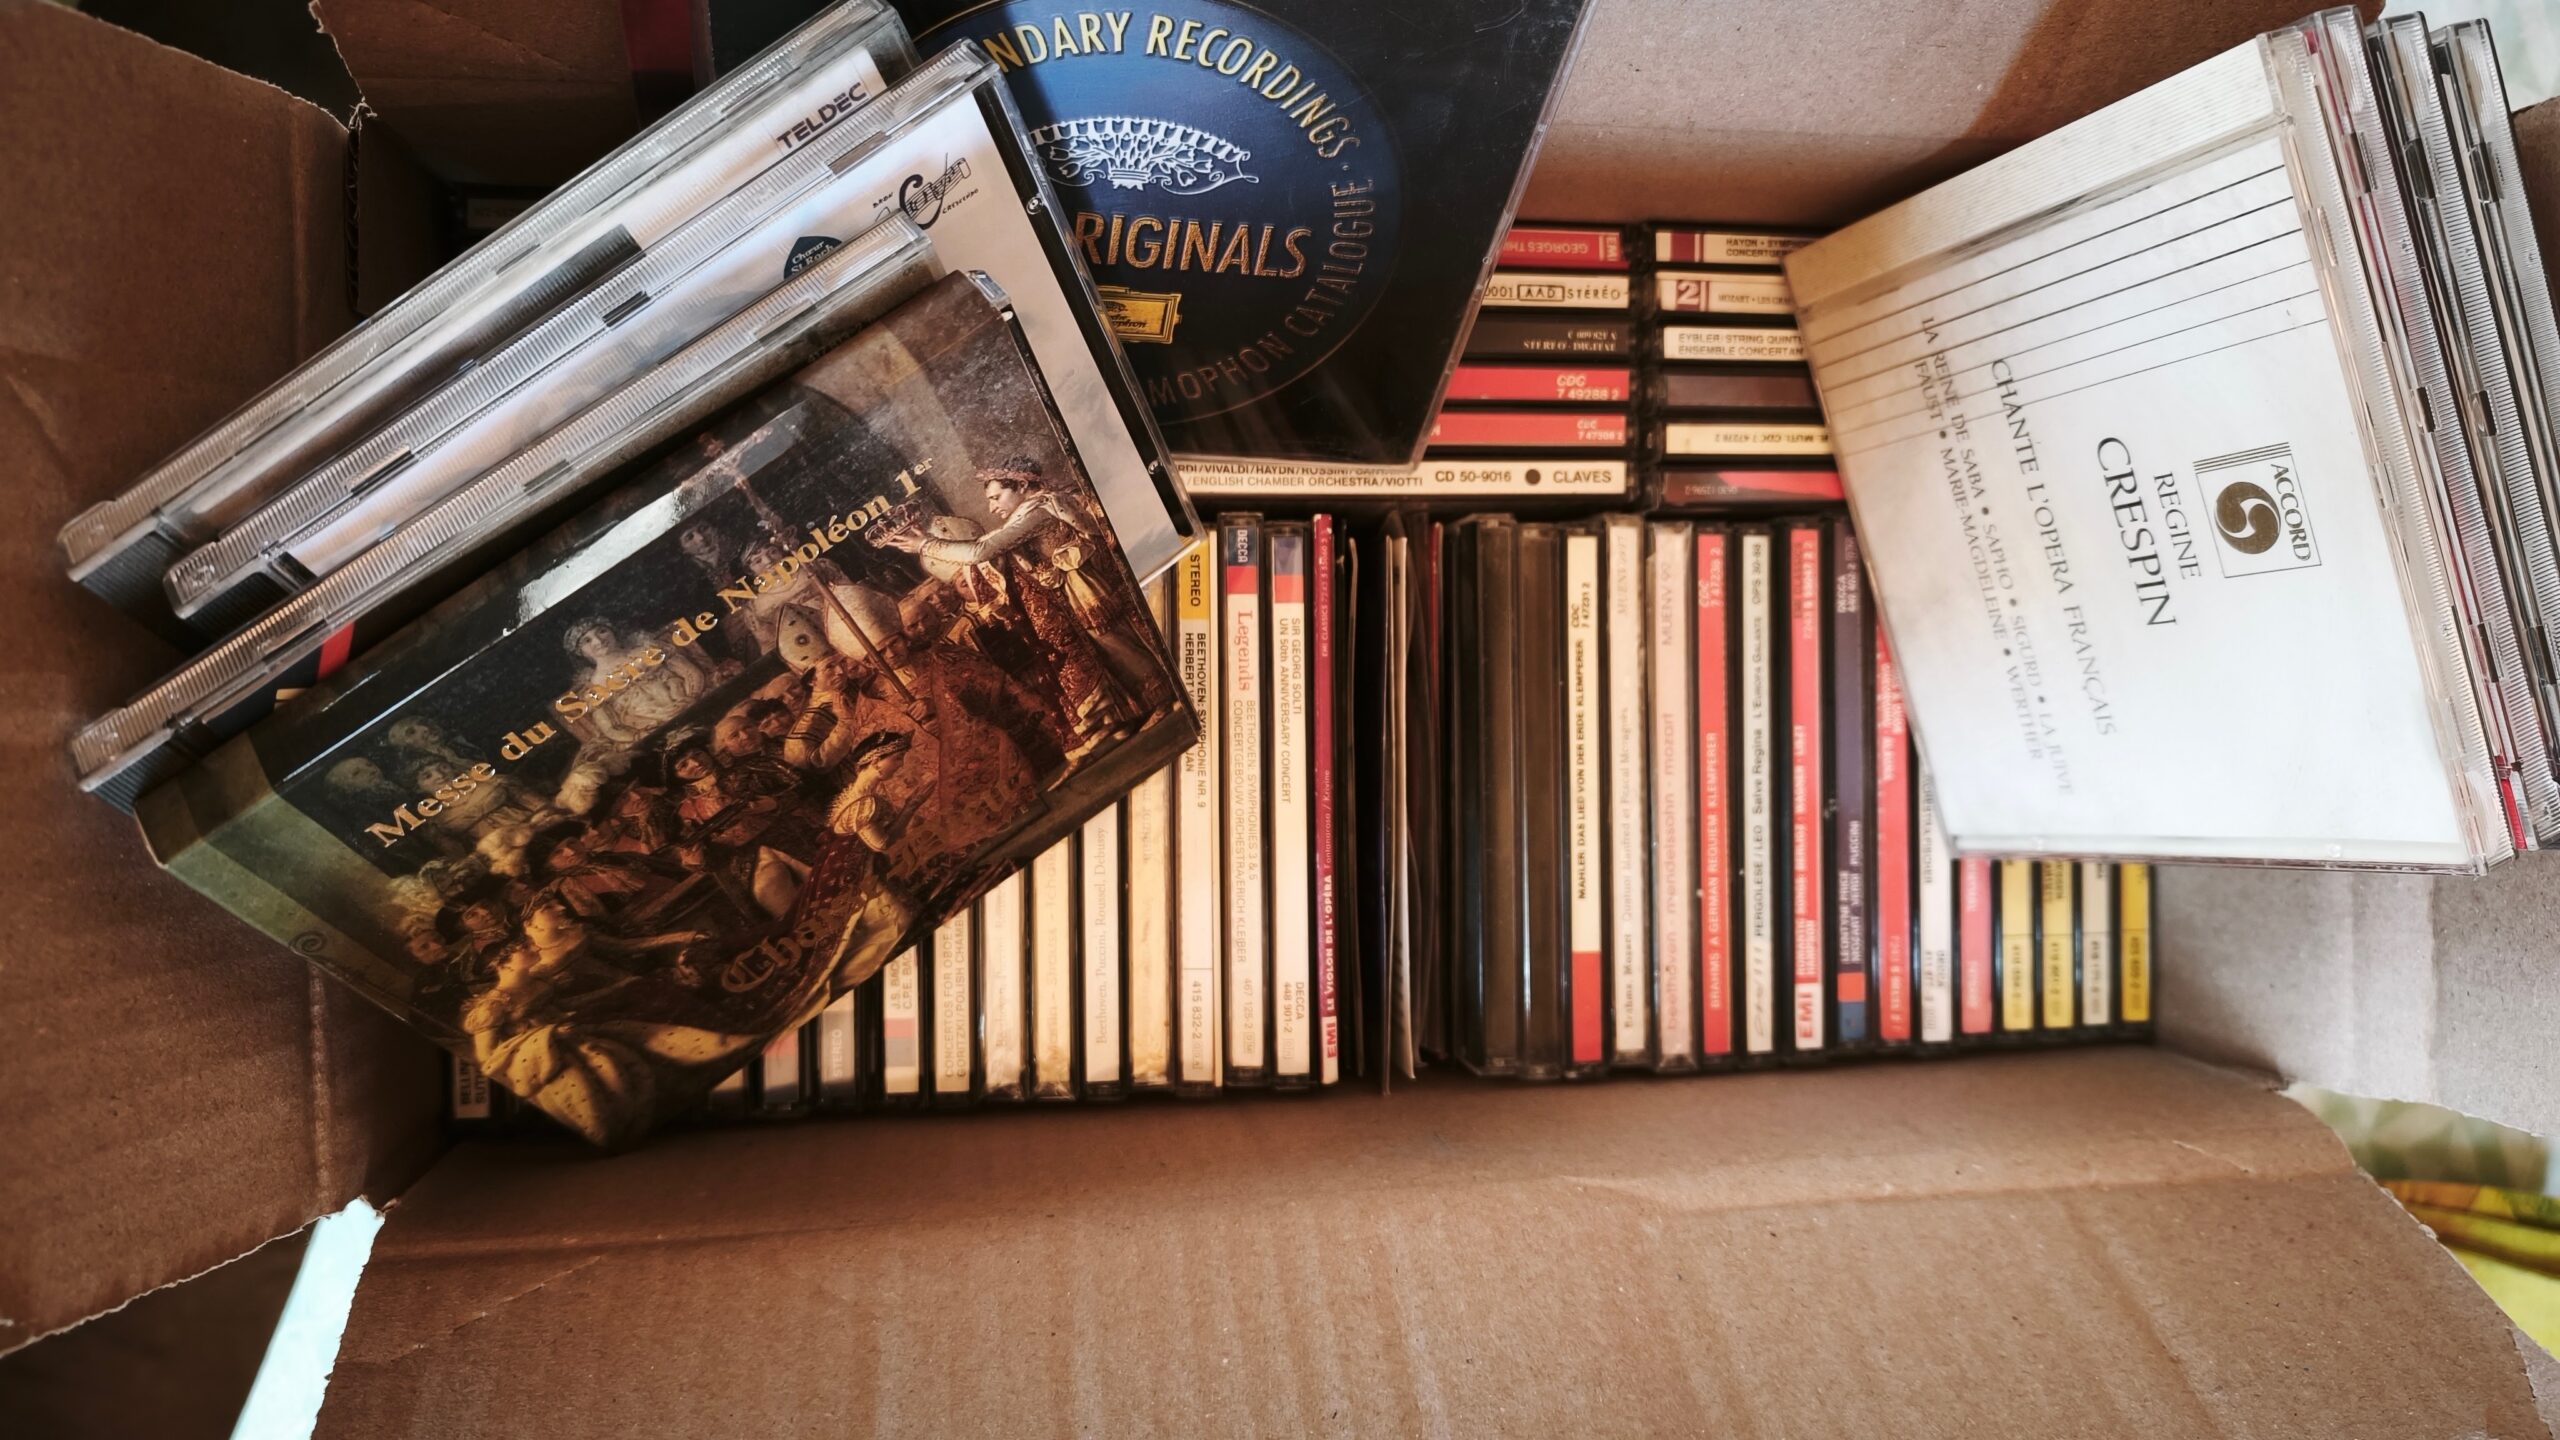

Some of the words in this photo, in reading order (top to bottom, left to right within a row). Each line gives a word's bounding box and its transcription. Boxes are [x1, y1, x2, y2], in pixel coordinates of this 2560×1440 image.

[982, 12, 1132, 73] NDARY
[1145, 14, 1361, 159] RECORDINGS
[777, 82, 866, 149] TELDEC
[1075, 211, 1313, 279] RIGINALS
[1528, 241, 1589, 255] GEORGES
[1148, 331, 1294, 411] MOPHON
[1284, 179, 1375, 337] CATALOGUE
[1524, 288, 1557, 299] AAD
[1567, 284, 1621, 299] STÉRÉO
[1677, 281, 1700, 305] 2
[1726, 334, 1764, 344] STRING
[1921, 316, 1939, 345] LA
[1678, 345, 1735, 355] ENSEMBLE
[1556, 375, 1586, 387] CDC
[1930, 351, 1960, 411] REINE
[1951, 414, 1970, 441] DE
[1247, 475, 1305, 487] CHAMBER
[1435, 470, 1455, 482] CD
[1460, 470, 1512, 482] 50-9016
[1553, 470, 1612, 483] CLAVES
[1960, 446, 1985, 500] SABA
[2097, 437, 2177, 626] CRESPIN
[2154, 473, 2202, 579] REGINE
[2270, 463, 2311, 562] ACCORD
[1236, 530, 1247, 562] DECCA
[1914, 360, 1945, 422] FAUST
[2005, 665, 2043, 761] WERTHER
[1982, 522, 2014, 591] SAPHO
[1189, 554, 1200, 607] STEREO
[1698, 579, 1709, 606] CDC
[1751, 579, 1761, 603] OPS
[1278, 618, 1288, 635] UN
[1291, 618, 1300, 636] SIR
[1321, 604, 1329, 639] CLASSICS
[1571, 603, 1580, 627] CDC
[1184, 633, 1193, 685] HERBERT
[1234, 611, 1254, 690] Legends
[1279, 639, 1288, 662] 50th
[1291, 640, 1300, 679] GEORG
[2010, 614, 2042, 688] SIGURD
[364, 759, 497, 849] Messe
[500, 713, 558, 762] du
[554, 645, 667, 723] Sacre
[671, 608, 719, 650] de
[717, 493, 893, 615] Napoléon
[1195, 633, 1205, 707] BEETHOVEN:
[2063, 605, 2117, 737] FRANÇAIS
[1279, 666, 1290, 746] ANNIVERSARY
[1292, 683, 1301, 714] SOLTI
[1233, 700, 1245, 806] CONCERTGEBOUW
[1575, 742, 1585, 764] DER
[1661, 711, 1675, 775] mozart
[1751, 728, 1765, 773] Regina
[1280, 750, 1291, 803] CONCERT
[1322, 769, 1331, 800] Krivine
[1576, 768, 1585, 791] VON
[1705, 732, 1717, 807] KLEMPERER
[1246, 774, 1257, 849] SYMPHONIES
[1576, 795, 1585, 819] LIED
[1751, 778, 1763, 813] Salve
[1093, 826, 1107, 874] Debussy
[1577, 822, 1585, 845] DAS
[1661, 792, 1676, 913] mendelssohn
[1752, 824, 1763, 849] LEO
[1708, 876, 1719, 931] GERMAN
[1753, 860, 1763, 936] PERGOLESE
[1838, 870, 1849, 900] PRICE
[943, 932, 953, 967] OBOE
[1234, 917, 1246, 963] KLEIBER
[1325, 928, 1334, 943] DE
[1708, 935, 1719, 945] A
[1838, 904, 1849, 963] LEONTYNE
[1850, 915, 1861, 962] MOZART
[902, 948, 913, 974] BAC
[1323, 947, 1335, 994] VIOLON
[1663, 931, 1677, 1029] beethoven
[943, 972, 953, 996] FOR
[1191, 981, 1200, 1001] 415
[1282, 982, 1292, 1001] 448
[1294, 982, 1304, 1020] DECCA
[1326, 997, 1335, 1009] LE
[1191, 1006, 1201, 1039] 832-2
[1282, 1005, 1292, 1033] 901-2
[1798, 991, 1814, 1037] EMI
[831, 1028, 844, 1076] STEREO
[943, 999, 955, 1076] CONCERTOS
[1326, 1022, 1337, 1057] EMI
